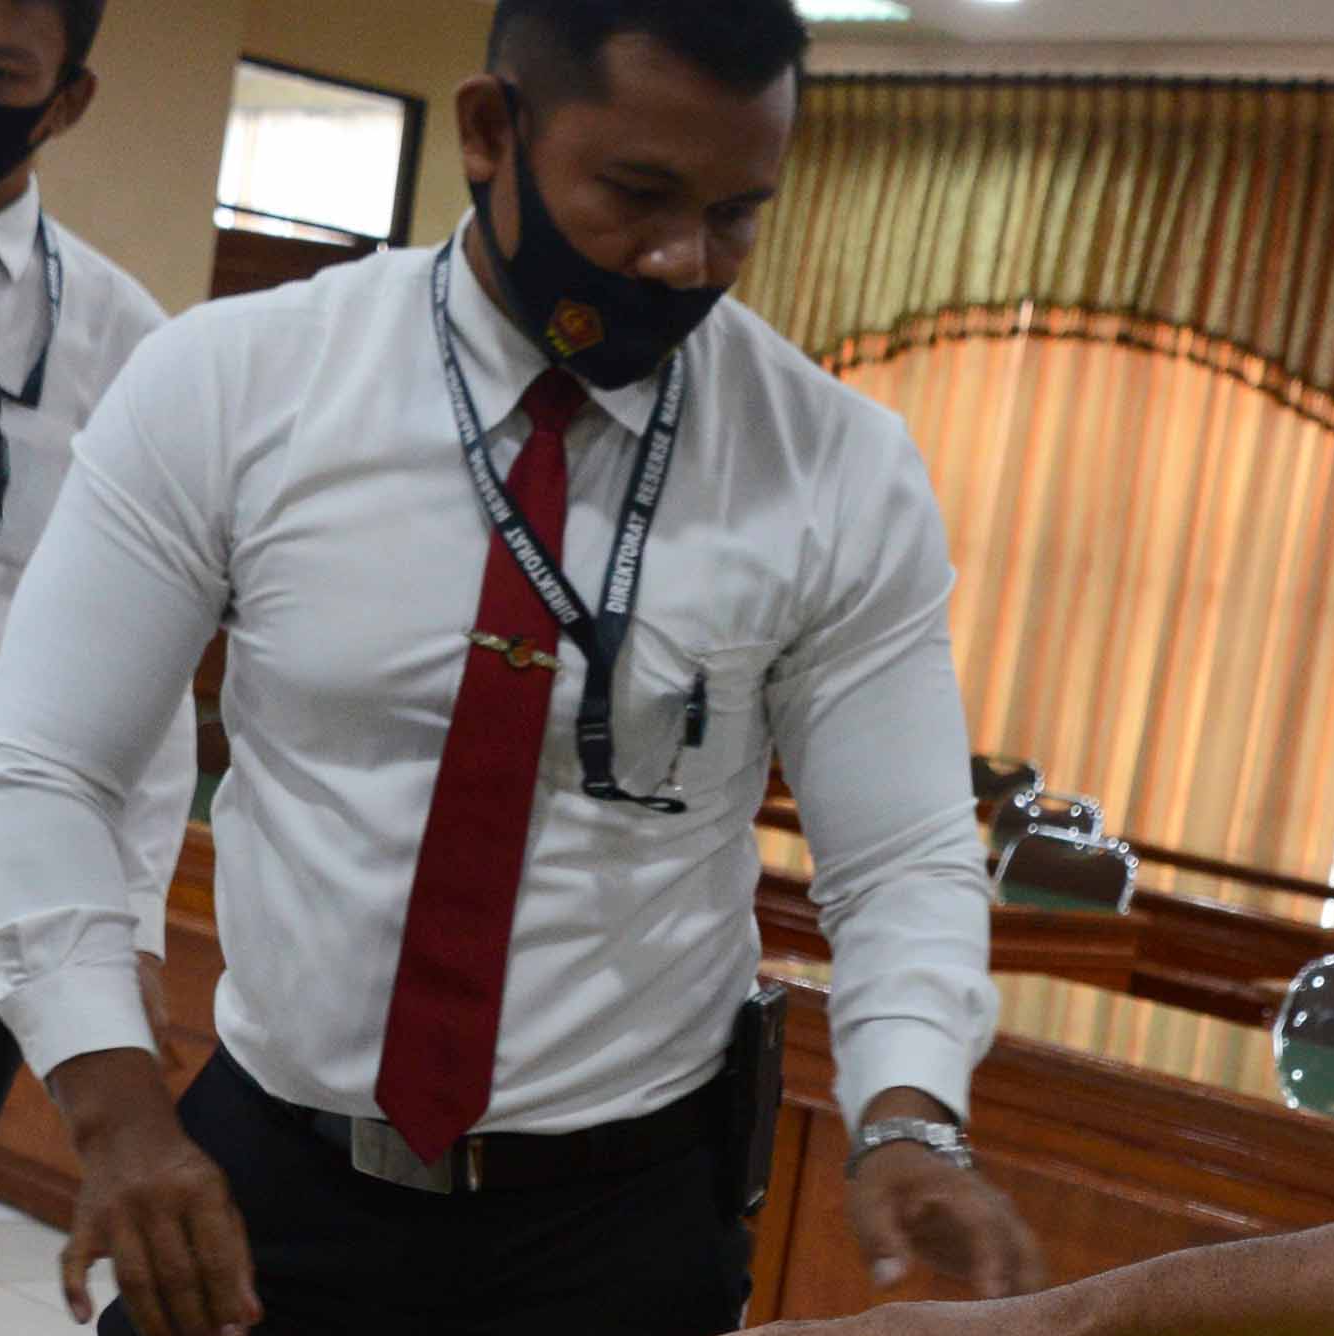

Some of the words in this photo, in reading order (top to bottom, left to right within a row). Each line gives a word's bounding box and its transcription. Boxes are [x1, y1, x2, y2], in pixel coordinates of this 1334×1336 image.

[504, 526, 579, 624] DIREKTORAT
[605, 510, 647, 614] DIREKTORAT
[635, 428, 671, 507] RESERSE
